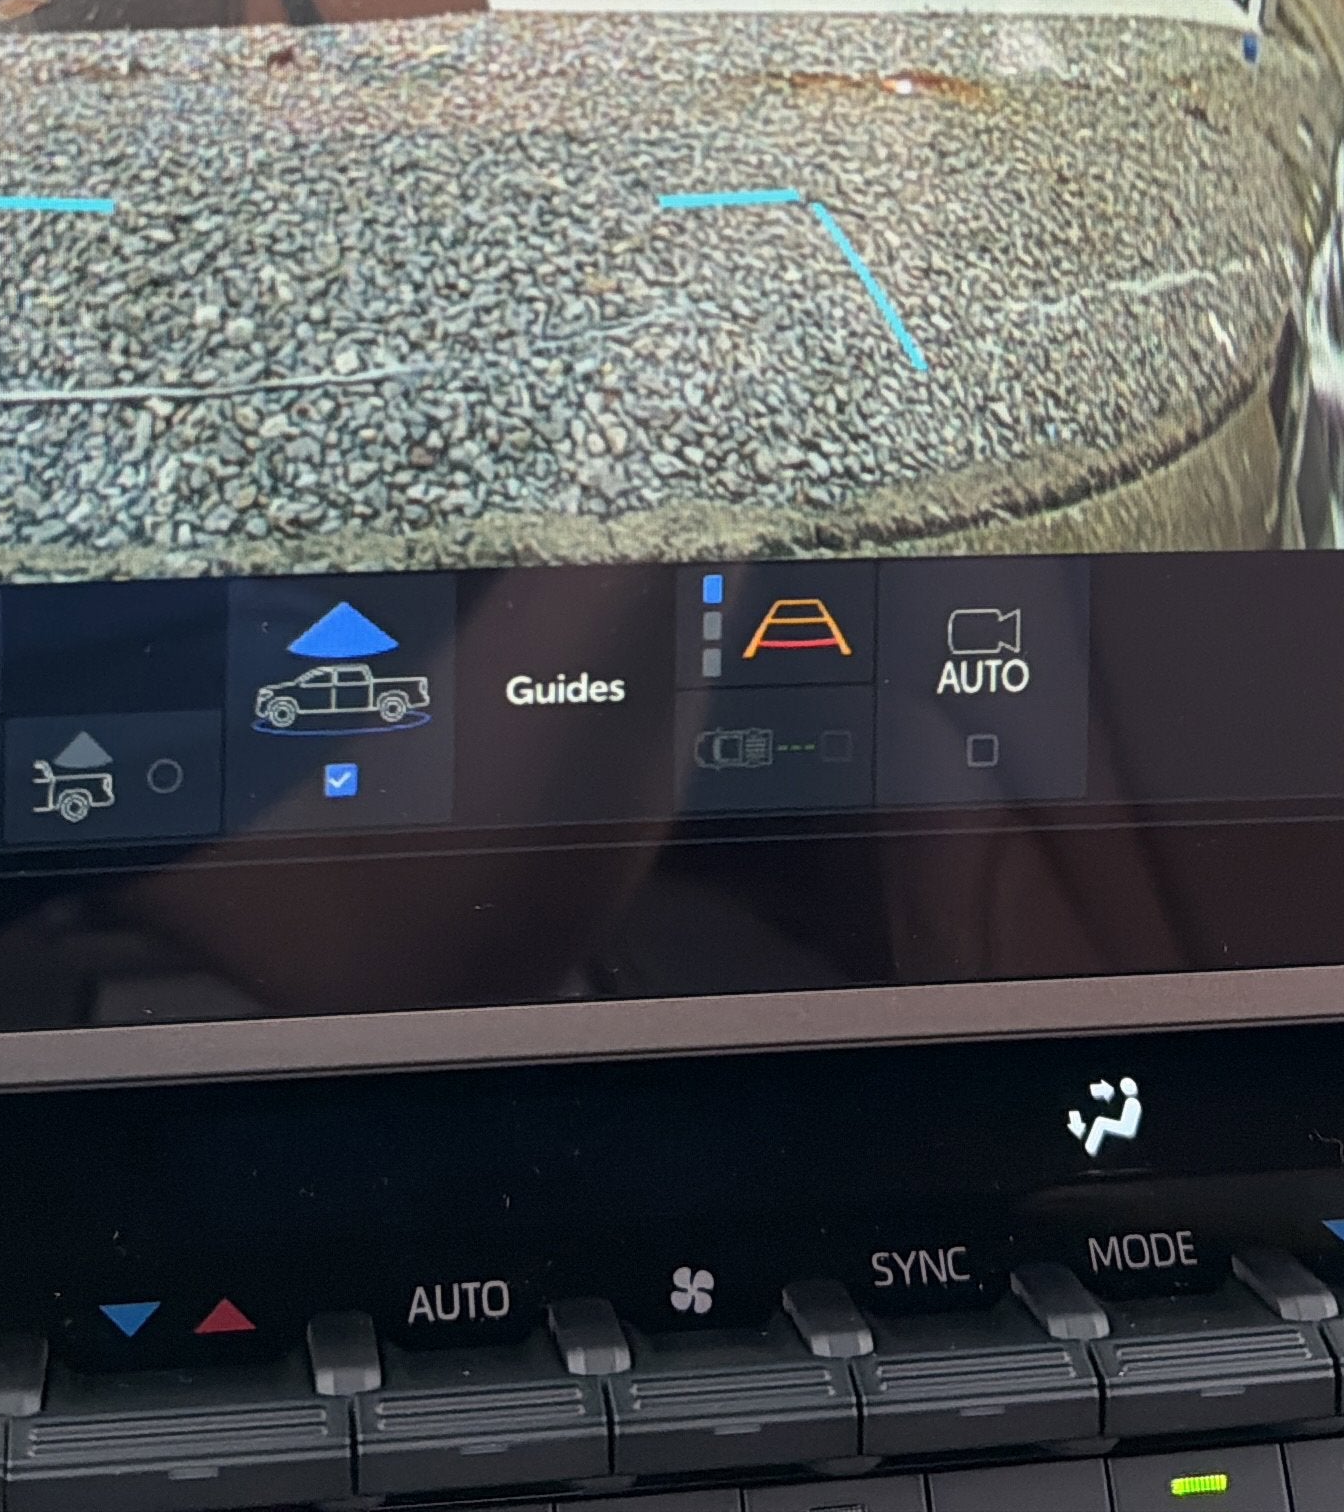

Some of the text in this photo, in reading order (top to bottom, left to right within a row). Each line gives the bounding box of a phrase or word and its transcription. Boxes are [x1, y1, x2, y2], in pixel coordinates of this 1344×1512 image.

[505, 671, 626, 707] Guides
[936, 658, 1031, 695] AUTO
[870, 1245, 972, 1288] SYNC
[1087, 1229, 1199, 1273] MODE
[406, 1278, 511, 1325] AUTO
